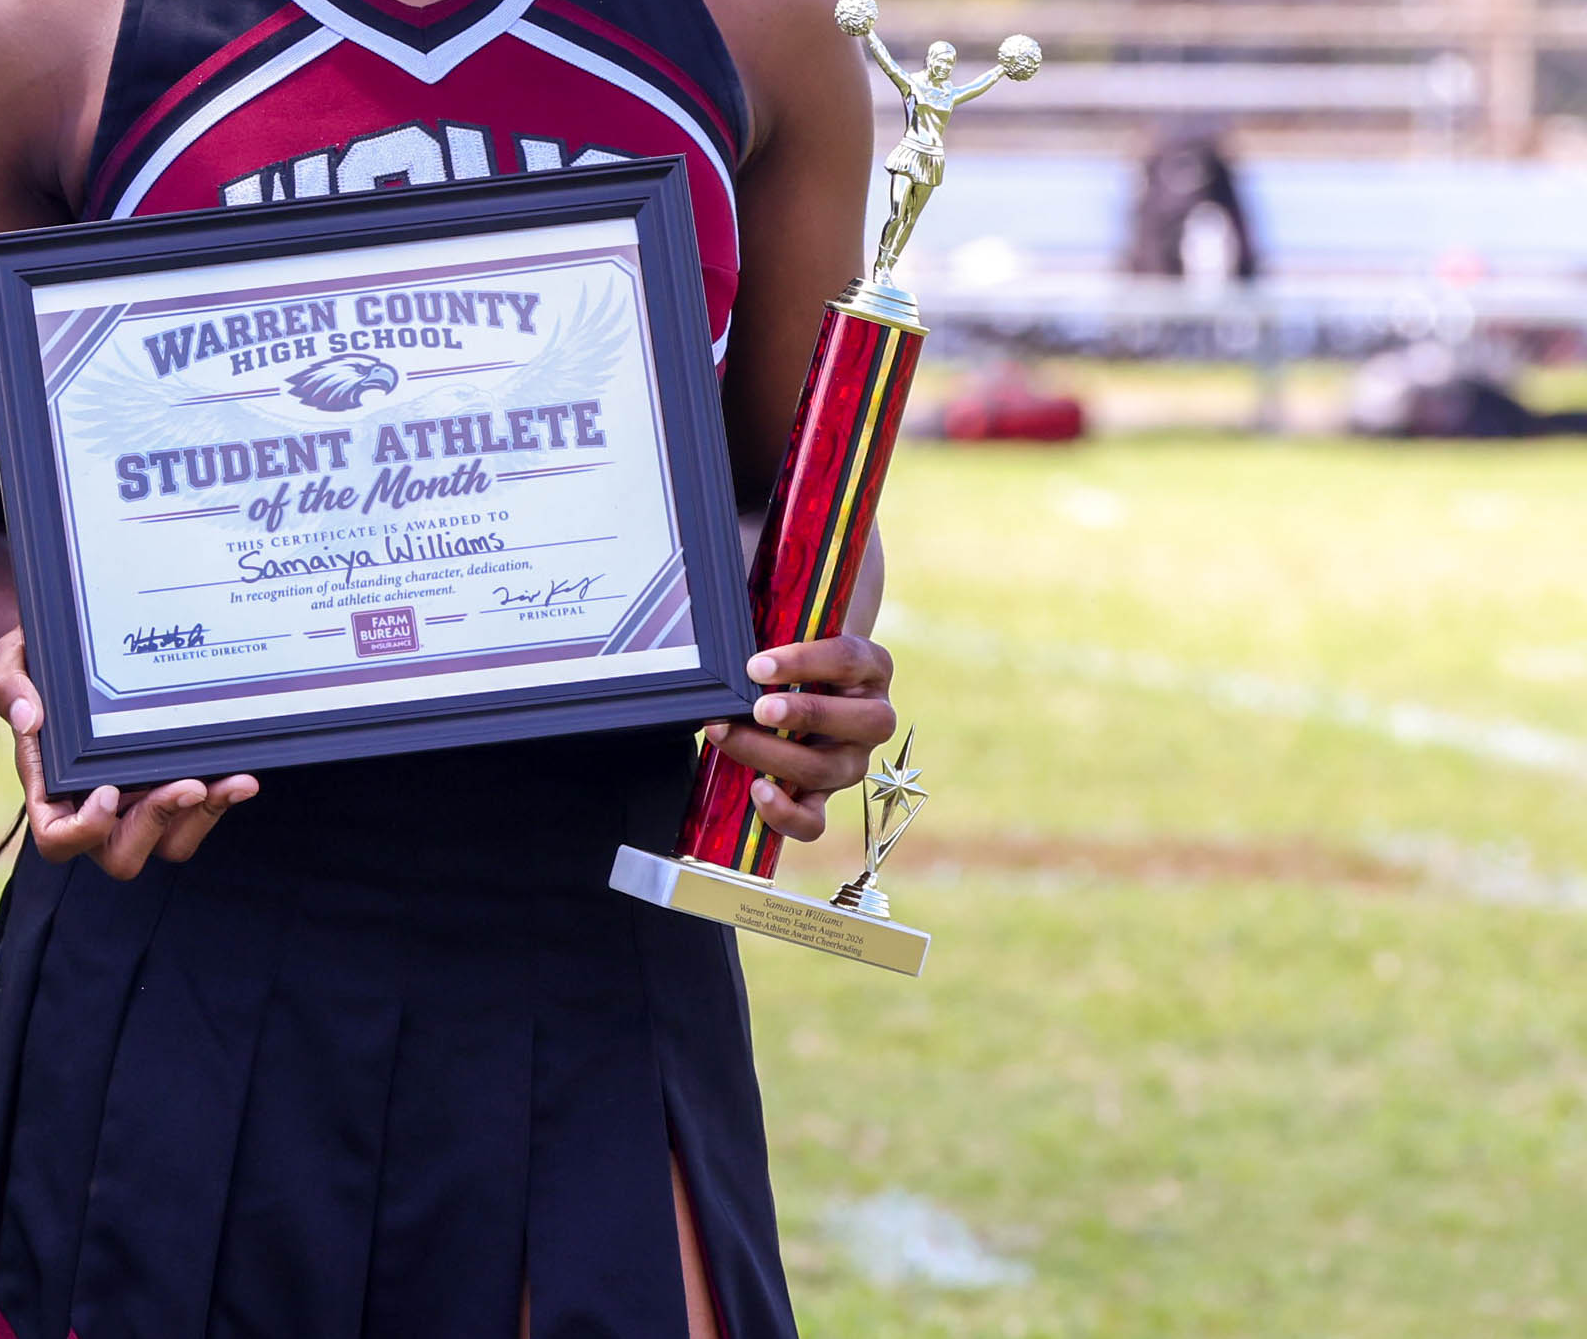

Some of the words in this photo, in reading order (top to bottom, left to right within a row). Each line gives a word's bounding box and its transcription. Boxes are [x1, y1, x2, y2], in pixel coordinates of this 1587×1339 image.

[142, 299, 338, 379] WARREN
[355, 290, 540, 336] COUNTY
[229, 336, 317, 376] HIGH
[329, 328, 462, 354] SCHOOL
[115, 428, 353, 503] STUDENT
[372, 398, 608, 465] ATHLETE
[248, 482, 290, 533] of
[299, 476, 359, 515] the
[362, 458, 493, 514] Month
[227, 540, 264, 553] THIS
[271, 526, 377, 547] CERTIFICATE
[384, 524, 397, 534] IS
[405, 514, 481, 532] AWARDED
[488, 511, 509, 522] TO
[238, 546, 379, 587] Samaiya
[385, 532, 504, 564] Williams
[230, 592, 243, 604] In
[246, 585, 313, 602] recognition
[316, 581, 332, 597] of
[331, 574, 402, 591] outstanding
[405, 569, 464, 583] character,
[466, 560, 533, 577] dedication,
[311, 598, 333, 610] and
[337, 593, 381, 608] athletic
[384, 585, 456, 602] achievement.
[360, 625, 410, 640] BUREAU
[372, 614, 408, 628] FARM
[519, 606, 585, 621] PRINCIPAL
[153, 650, 207, 663] ATHLETIC
[211, 643, 267, 657] DIRECTOR
[740, 903, 764, 917] Warren
[767, 912, 791, 924] County
[794, 919, 817, 932] Eagles
[819, 926, 844, 938] August
[845, 933, 864, 944] 2026
[764, 898, 802, 916] Samaiya
[805, 909, 843, 927] Williams
[735, 914, 790, 934] Student-Athlete
[791, 929, 814, 942] Award
[816, 936, 862, 956] Cheerleading
